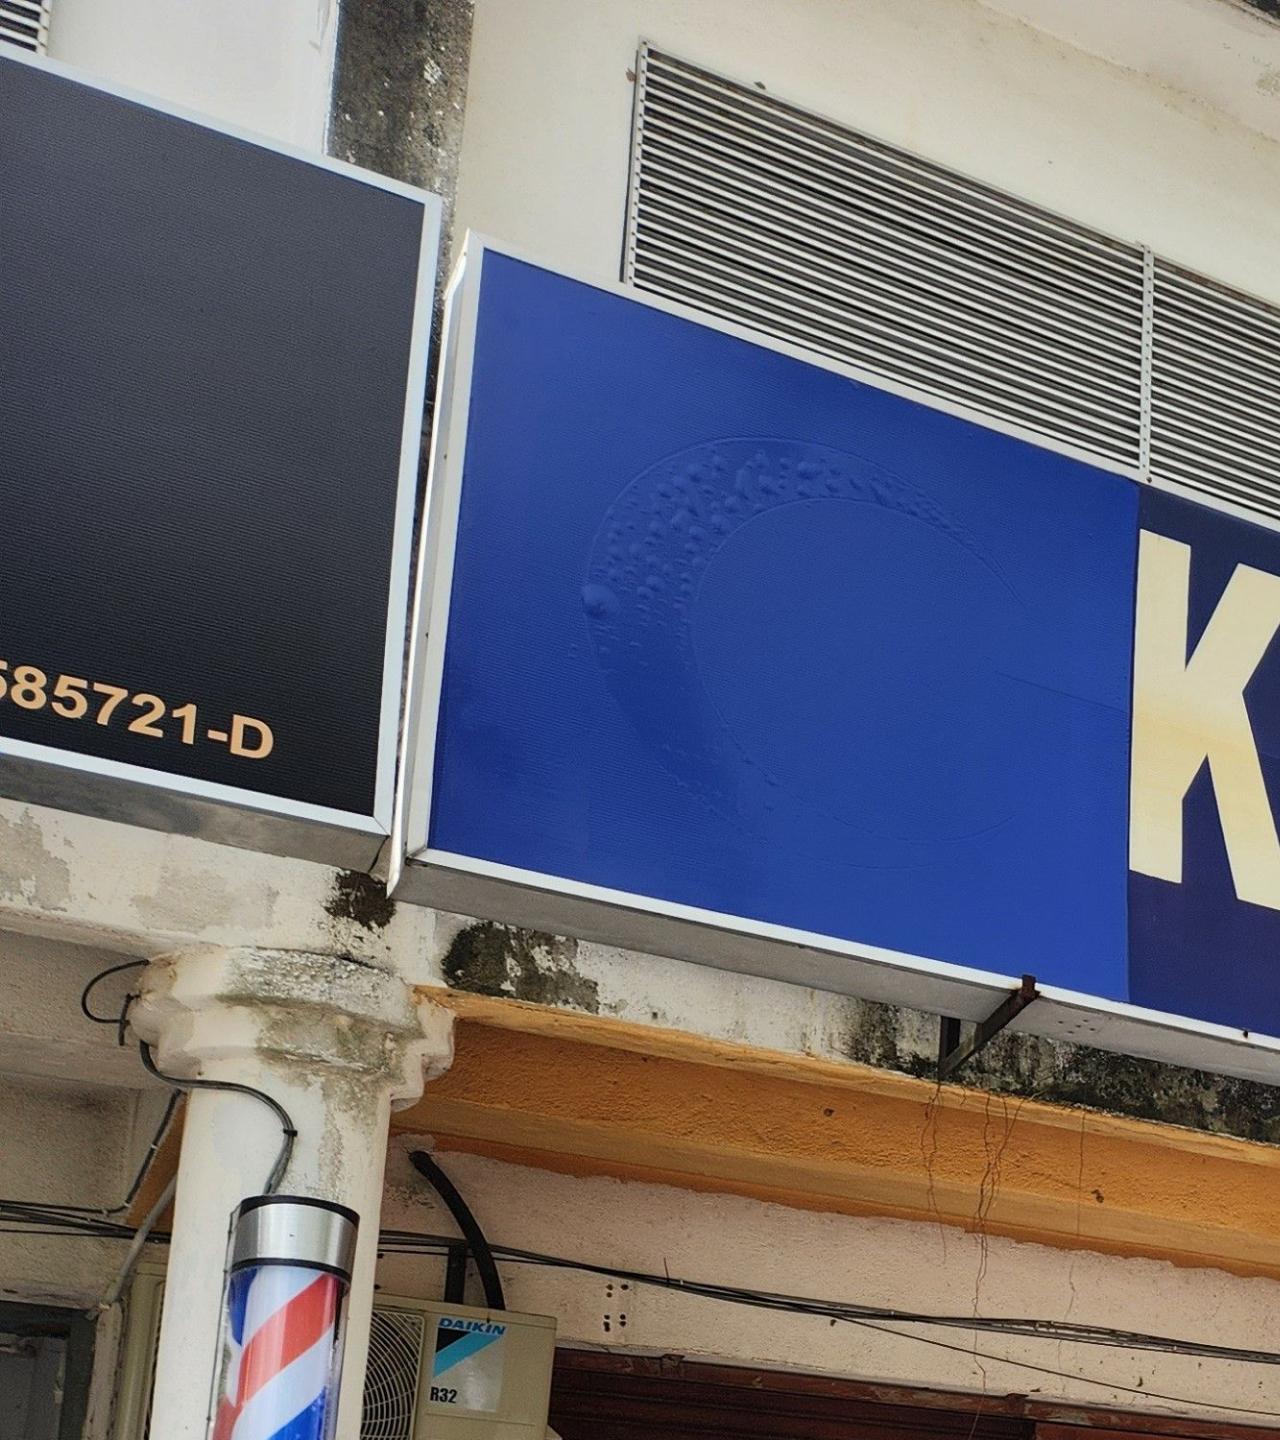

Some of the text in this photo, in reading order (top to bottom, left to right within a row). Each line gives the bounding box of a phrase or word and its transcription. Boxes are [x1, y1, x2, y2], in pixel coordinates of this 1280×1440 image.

[0, 659, 274, 759] 85721-D
[438, 1317, 507, 1336] DAIKIN
[430, 1386, 458, 1404] R32
